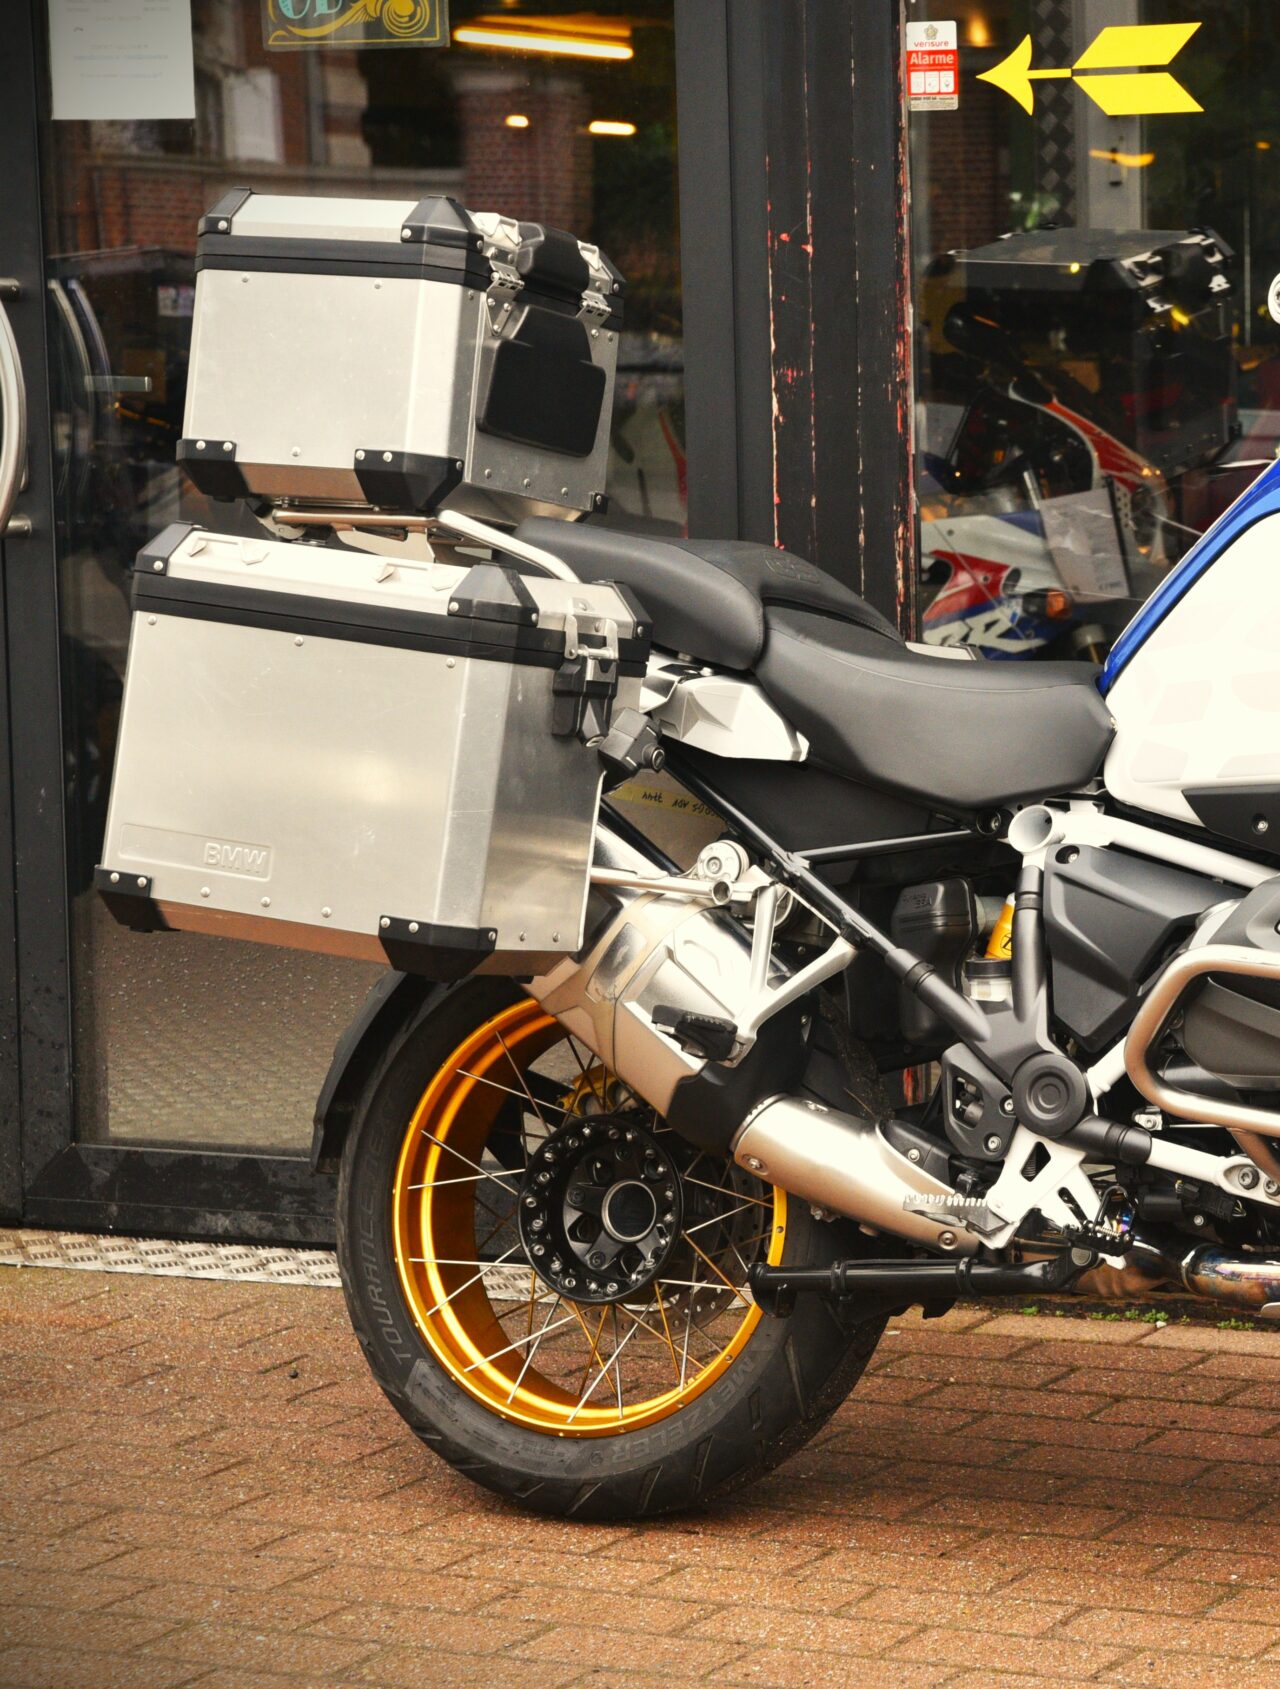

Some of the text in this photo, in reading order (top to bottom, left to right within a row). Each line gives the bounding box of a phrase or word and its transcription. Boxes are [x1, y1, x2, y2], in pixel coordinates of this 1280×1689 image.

[910, 52, 955, 65] Alarme
[913, 40, 949, 48] verisure
[203, 842, 267, 874] BMW
[358, 1194, 412, 1366] TOURANCE
[611, 1355, 752, 1465] METZELER
